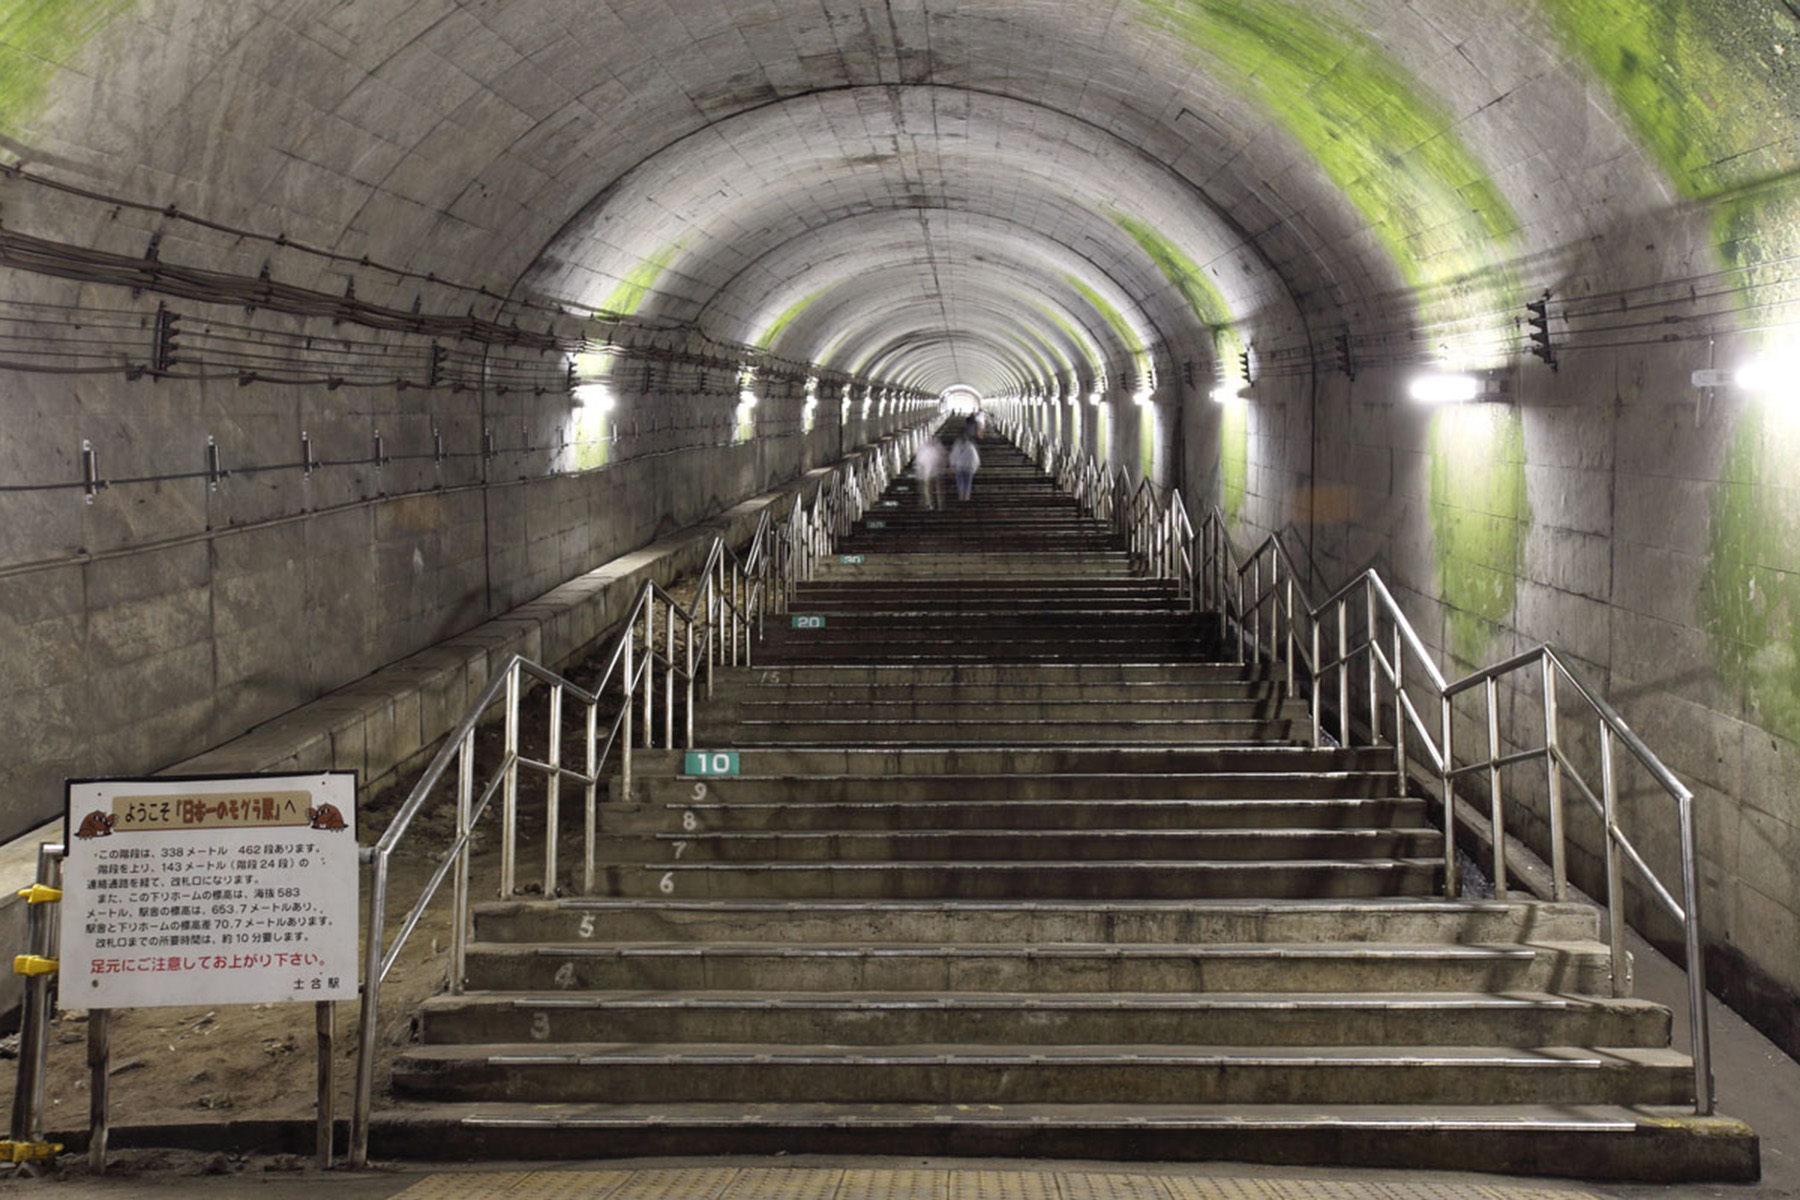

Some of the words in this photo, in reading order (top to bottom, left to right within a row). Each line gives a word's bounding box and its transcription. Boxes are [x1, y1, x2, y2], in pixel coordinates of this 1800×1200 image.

[797, 617, 820, 628] 20
[698, 754, 730, 773] 10
[691, 782, 707, 800] 9
[683, 811, 697, 830] 8
[672, 841, 687, 859] 7
[660, 872, 674, 893] 6
[578, 914, 595, 938] 5
[90, 952, 325, 974] 足元にご注意してお上がり下さい。
[531, 1013, 550, 1039] 3
